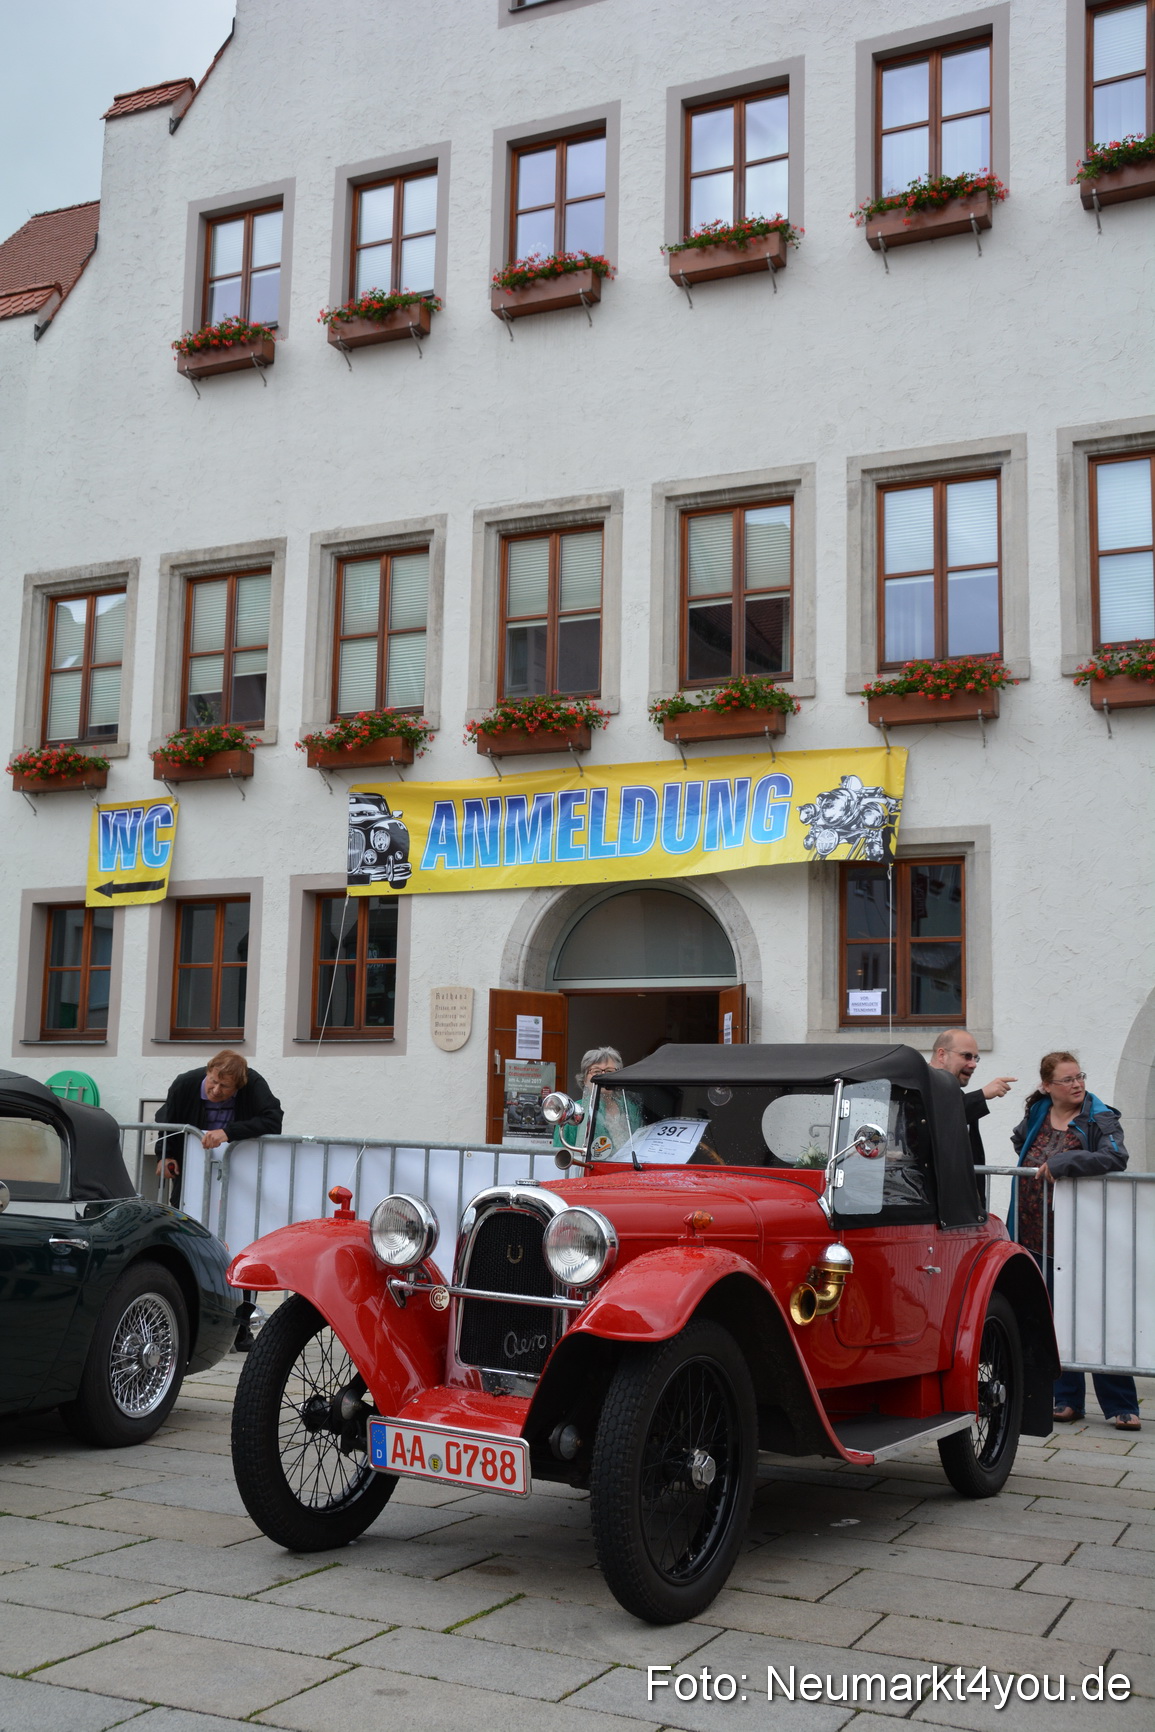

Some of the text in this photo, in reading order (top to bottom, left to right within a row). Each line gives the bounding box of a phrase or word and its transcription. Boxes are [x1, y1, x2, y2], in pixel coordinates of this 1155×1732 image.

[98, 803, 175, 872] WC
[420, 771, 794, 872] ANMELDUNG
[657, 1125, 688, 1137] 397
[376, 1449, 383, 1459] D
[391, 1431, 517, 1485] AA 0788
